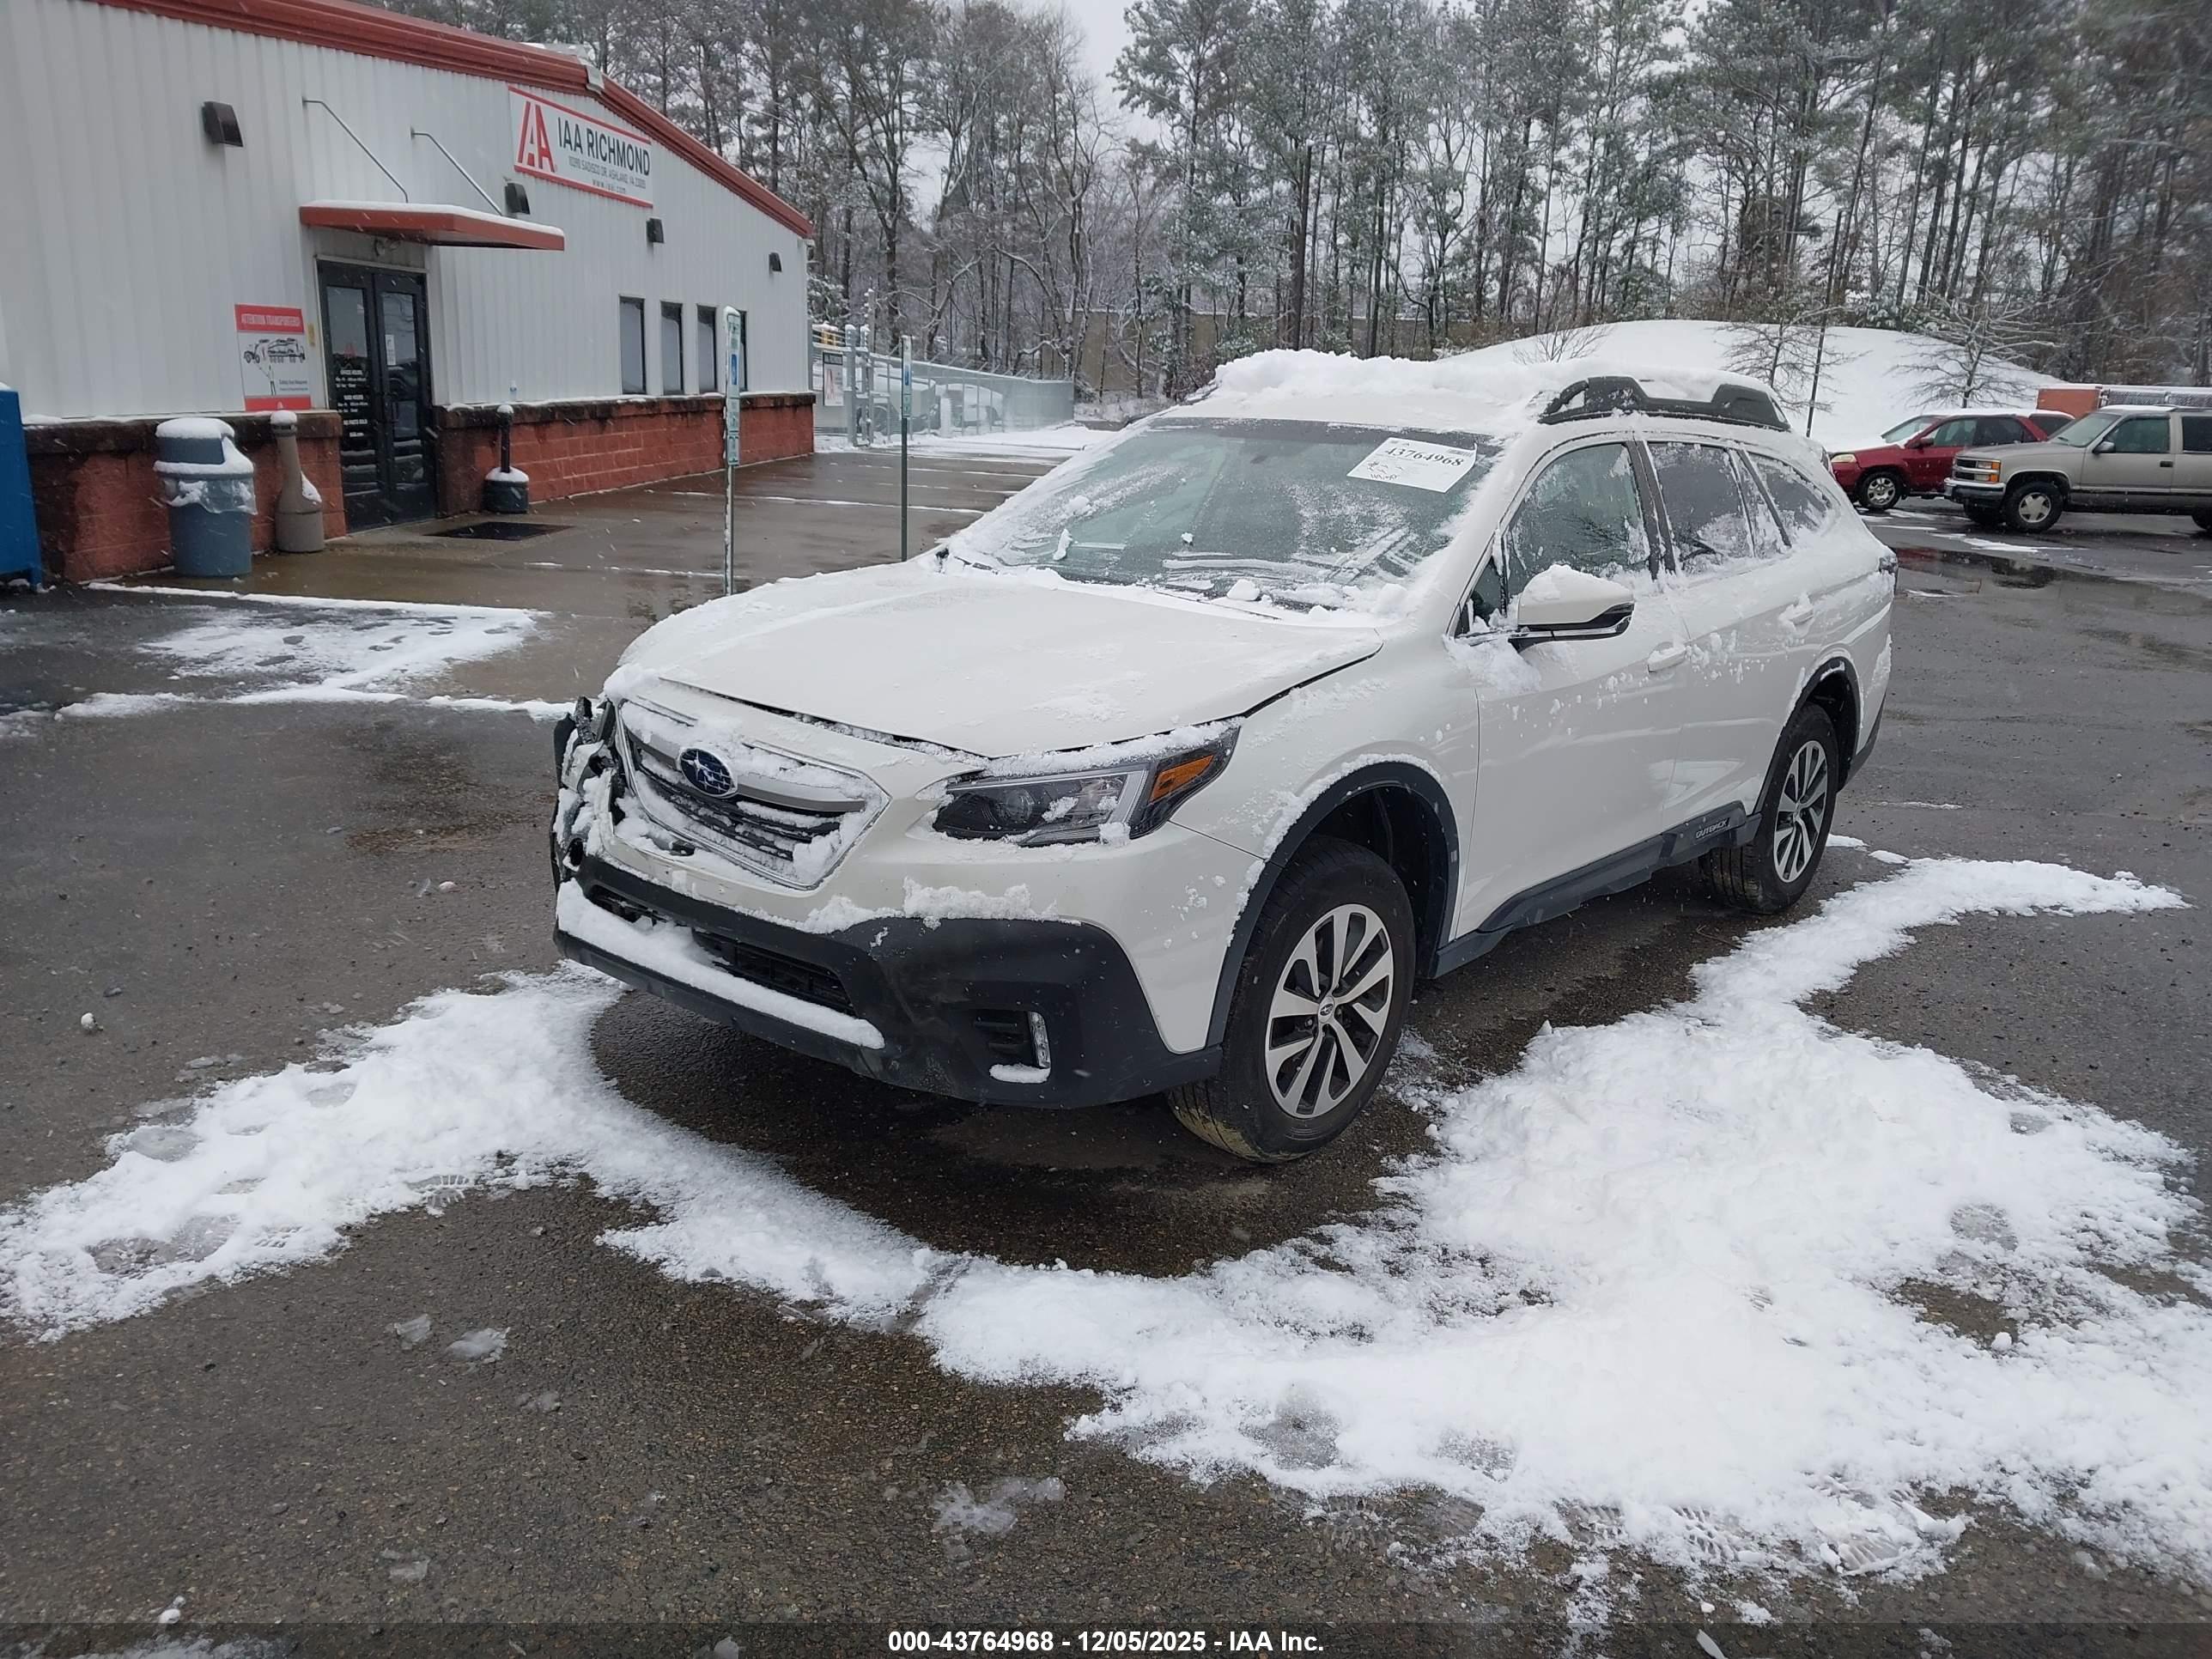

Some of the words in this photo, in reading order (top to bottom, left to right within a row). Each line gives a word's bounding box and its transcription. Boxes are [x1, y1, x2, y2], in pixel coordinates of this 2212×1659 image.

[557, 116, 584, 155] IAA
[586, 127, 650, 176] RICHMOND
[1385, 447, 1464, 467] 43764968
[1695, 819, 1728, 839] OUTBACK
